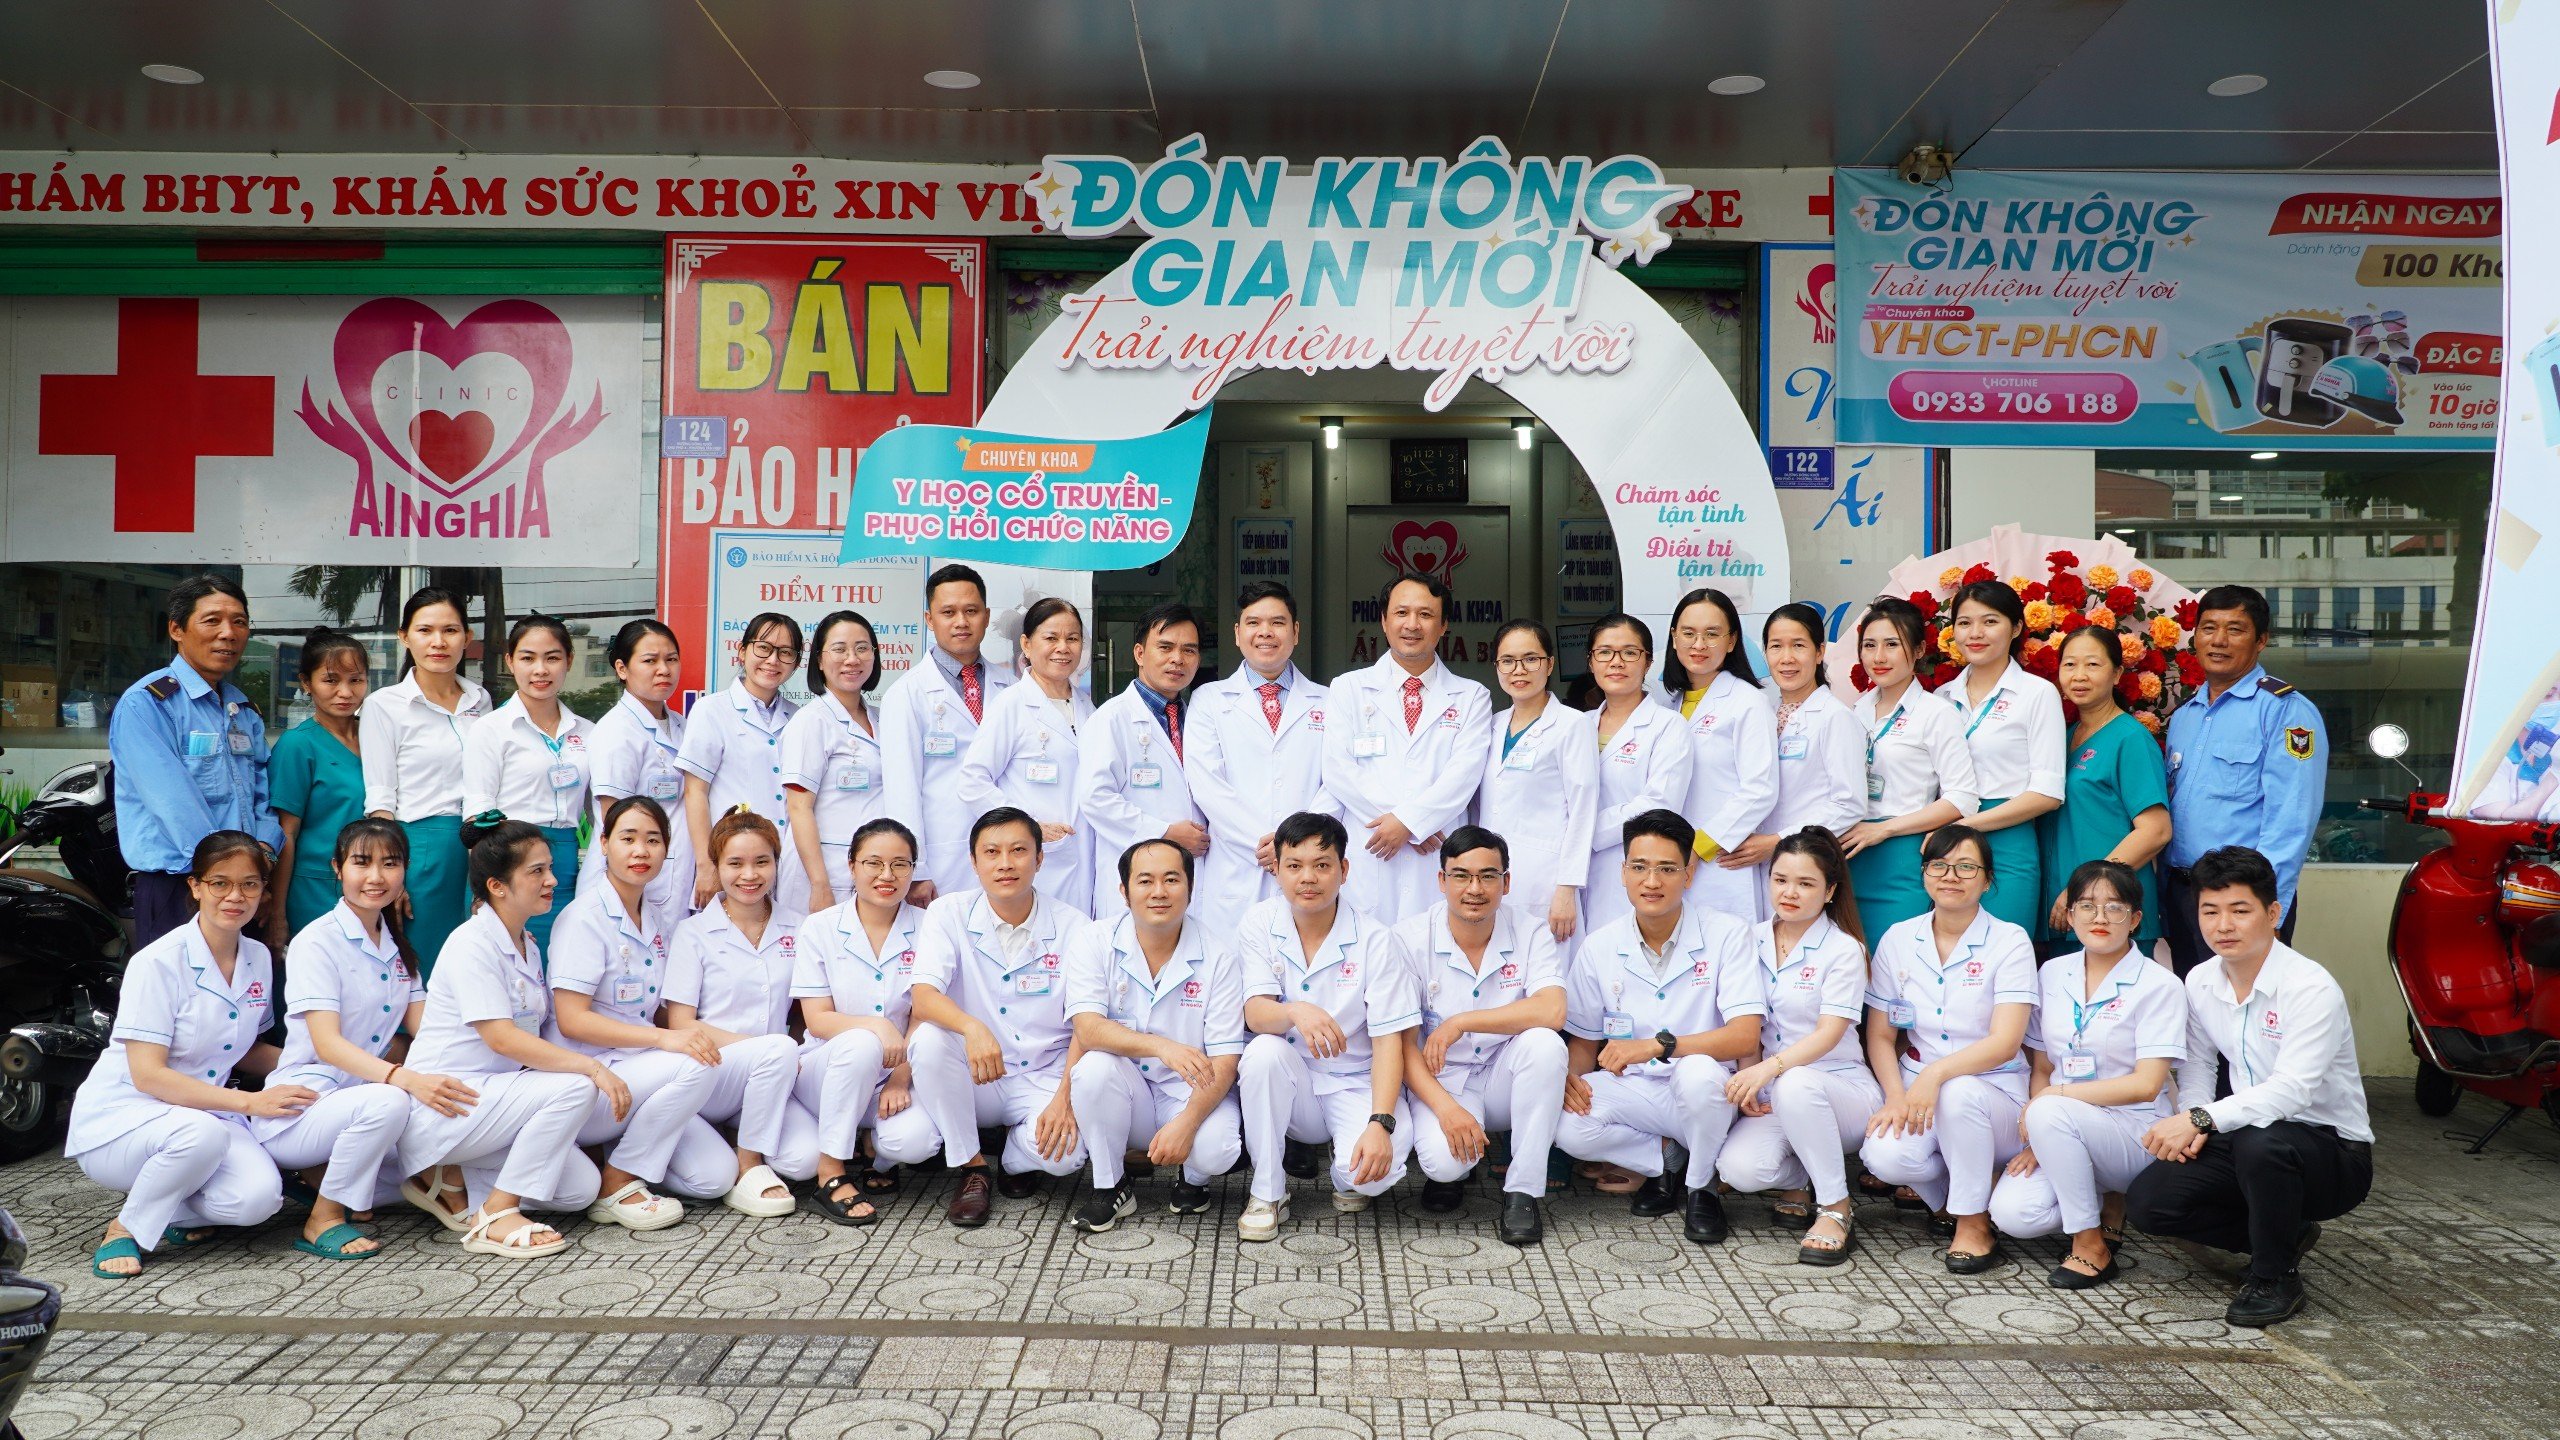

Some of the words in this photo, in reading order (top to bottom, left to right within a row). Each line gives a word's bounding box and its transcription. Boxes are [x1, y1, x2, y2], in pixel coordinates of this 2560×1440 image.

[143, 174, 314, 223] BHYT,
[333, 165, 508, 216] KHÁM
[525, 166, 638, 217] SỨC
[656, 164, 818, 220] KHOẺ
[833, 180, 941, 221] XIN
[1055, 139, 1287, 229] ĐÓN
[1308, 141, 1685, 229] KHÔNG
[1665, 190, 1743, 228] XE
[1868, 190, 1989, 232] ĐÓN
[2003, 192, 2208, 236] KHÔNG
[2301, 200, 2396, 232] NHẬN
[2405, 205, 2496, 226] NGAY
[1132, 237, 1371, 308] GIAN
[1395, 217, 1588, 309] MỚI
[1907, 236, 2038, 271] GIAN
[2053, 228, 2154, 273] MỚI
[2383, 253, 2438, 278] 100
[1871, 264, 1927, 297] Trải
[1934, 263, 2044, 308] nghiệm
[2052, 269, 2133, 317] tuyệt
[2135, 279, 2179, 300] vời
[699, 257, 952, 395] BÁN
[1886, 306, 1931, 319] Chuyên
[1934, 307, 1965, 318] khoa
[1063, 294, 1167, 361] Trải
[1180, 293, 1379, 401] nghiệm
[1393, 304, 1546, 404] tuyệt
[1547, 322, 1632, 363] vời
[1870, 321, 2158, 359] YHCT-PHCN
[2426, 342, 2483, 369] ĐẶC
[387, 385, 519, 401] CLINIC
[1991, 378, 2038, 388] HOTLINE
[2433, 382, 2454, 391] Vào
[2456, 382, 2473, 391] lúc
[1912, 391, 1986, 413] 0933
[1997, 392, 2052, 414] 706
[2065, 392, 2118, 414] 188
[2429, 394, 2460, 415] 10
[2460, 398, 2499, 420] giờ
[679, 421, 711, 441] 124
[980, 446, 1036, 468] CHUYÊN
[1041, 451, 1079, 469] KHOA
[1786, 452, 1818, 472] 122
[683, 417, 796, 527] BẢO
[896, 481, 913, 502] Y
[923, 481, 990, 513] HỌC
[998, 472, 1045, 508] CỔ
[1615, 483, 1679, 504] Chăm
[1685, 485, 1721, 504] sóc
[350, 482, 551, 539] AINGHIA
[867, 514, 940, 541] PHỤC
[949, 507, 998, 540] HỒI
[1005, 513, 1083, 541] CHỨC
[1092, 514, 1170, 541] NĂNG
[1658, 504, 1696, 527] tận
[1701, 504, 1747, 524] tình
[1646, 537, 1703, 560] Điều
[1707, 539, 1734, 560] trị
[1677, 557, 1715, 581] tận
[1720, 558, 1767, 577] tâm
[760, 574, 824, 603] ĐIỂM
[832, 584, 883, 604] THU
[893, 624, 900, 635] Y
[0, 1321, 47, 1341] HONDA
